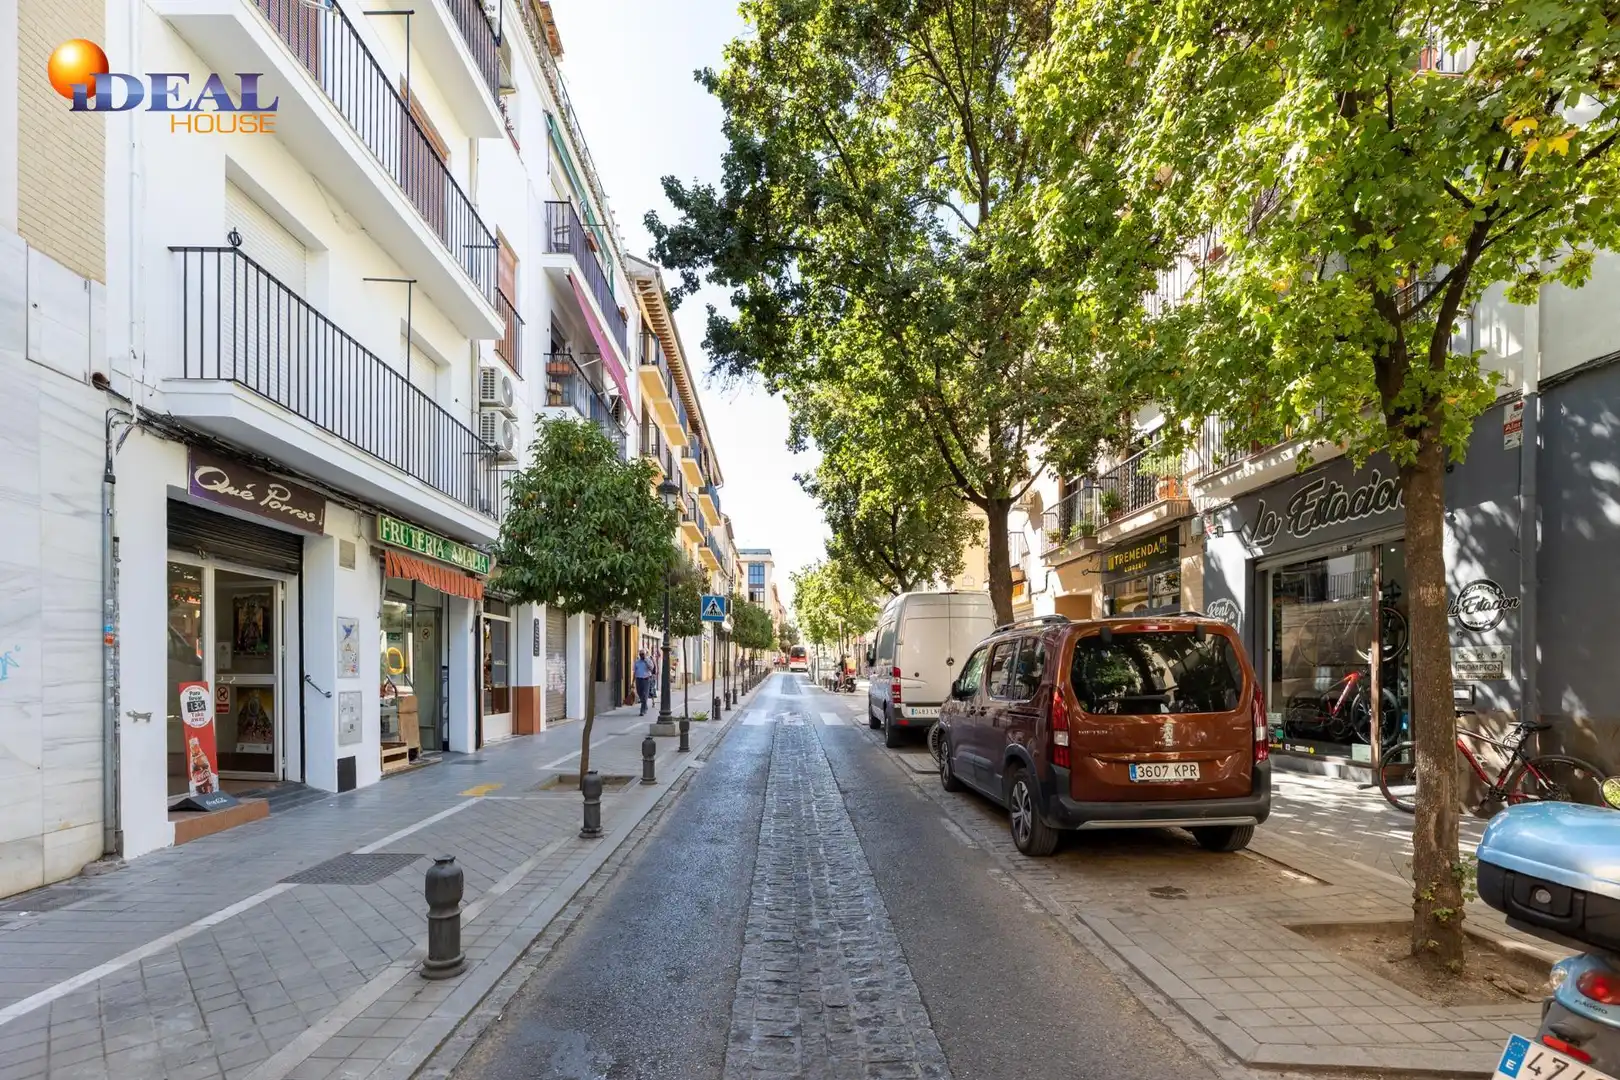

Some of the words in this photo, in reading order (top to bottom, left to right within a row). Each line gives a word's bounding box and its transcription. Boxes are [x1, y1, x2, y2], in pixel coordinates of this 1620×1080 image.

[194, 465, 256, 501] Qué
[1246, 499, 1283, 549] La
[382, 517, 445, 559] FRUTERIA
[450, 545, 488, 573] AMALIA
[1115, 541, 1160, 565] TREMENDA
[1207, 601, 1229, 618] Rent
[1138, 765, 1169, 779] 3607
[1174, 764, 1198, 777] KPR
[1527, 1052, 1606, 1080] 47
